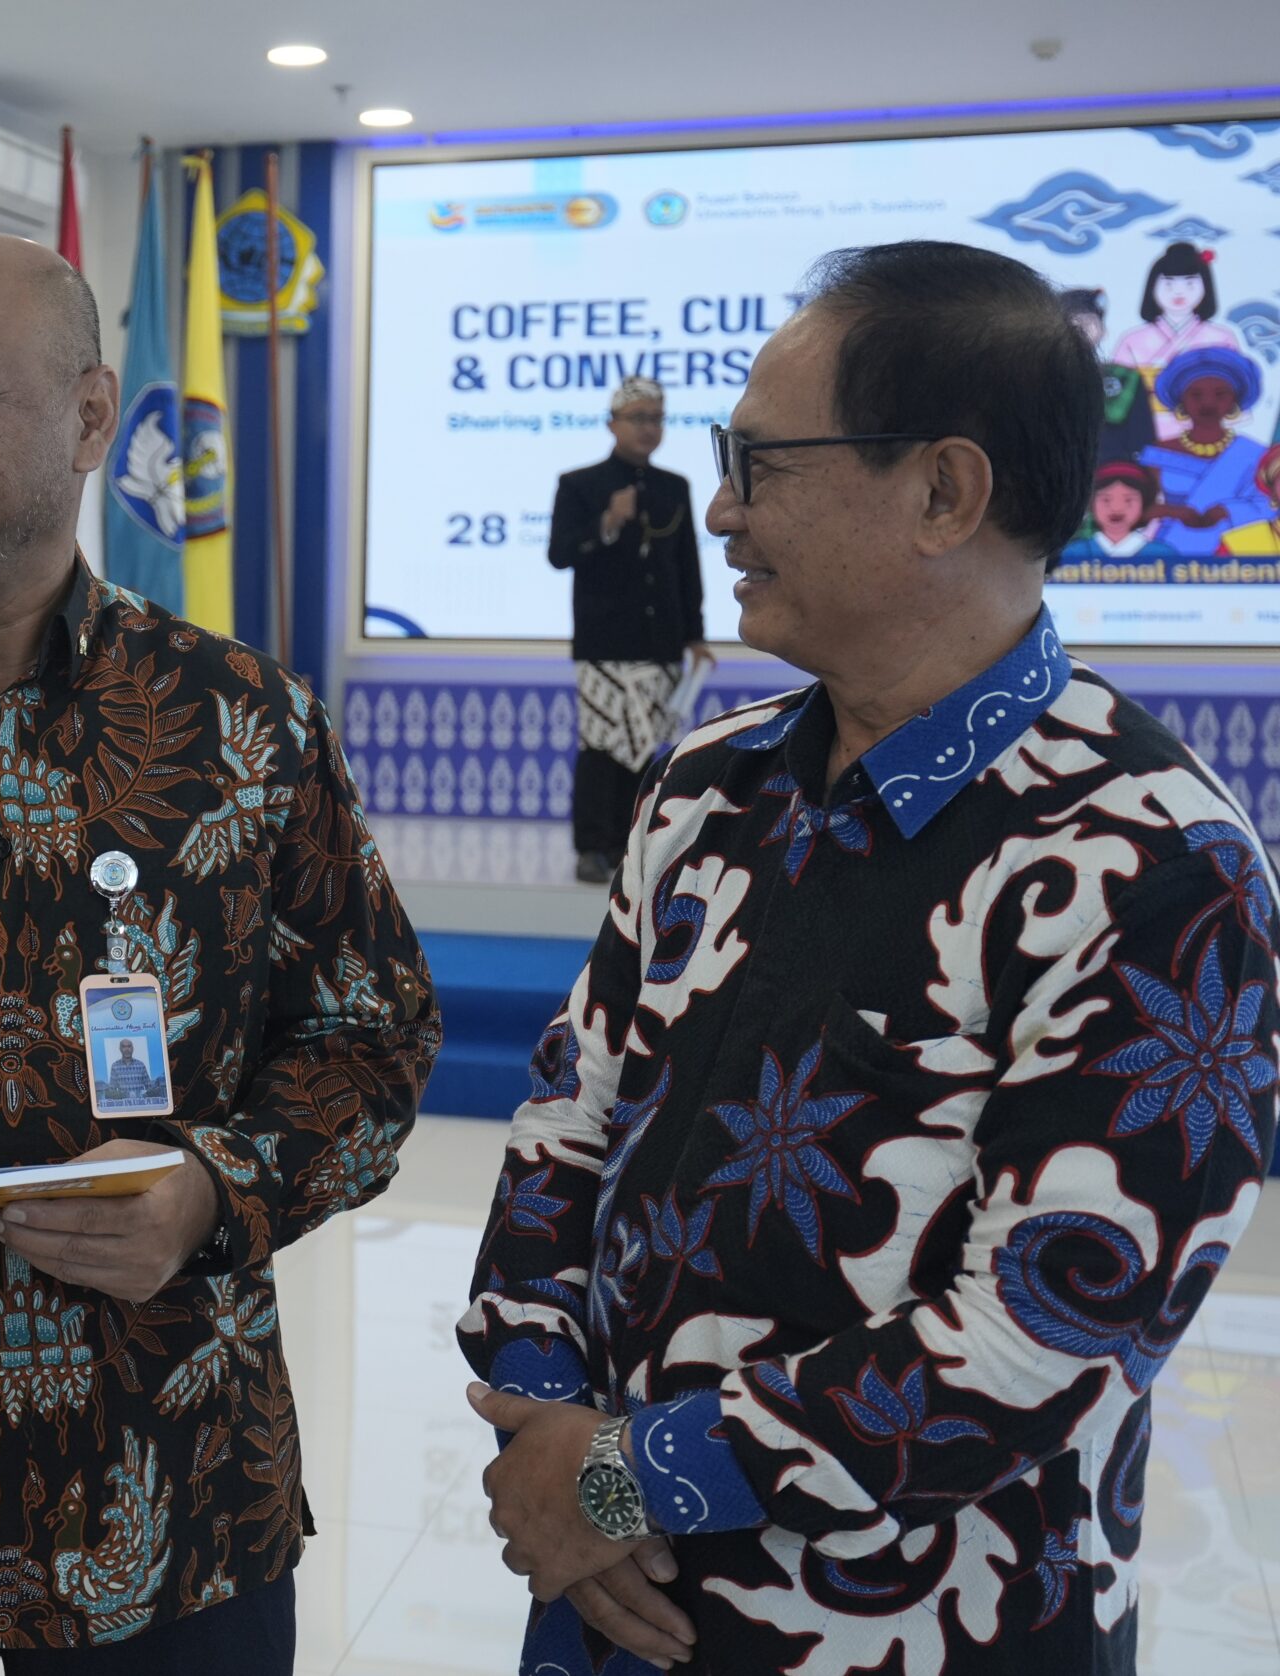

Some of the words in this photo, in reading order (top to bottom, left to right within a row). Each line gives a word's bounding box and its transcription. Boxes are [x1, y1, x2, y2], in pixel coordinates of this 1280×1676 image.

[450, 299, 662, 342] COFFEE,
[451, 355, 486, 391] &
[447, 411, 541, 434] Sharing
[447, 514, 507, 545] 28
